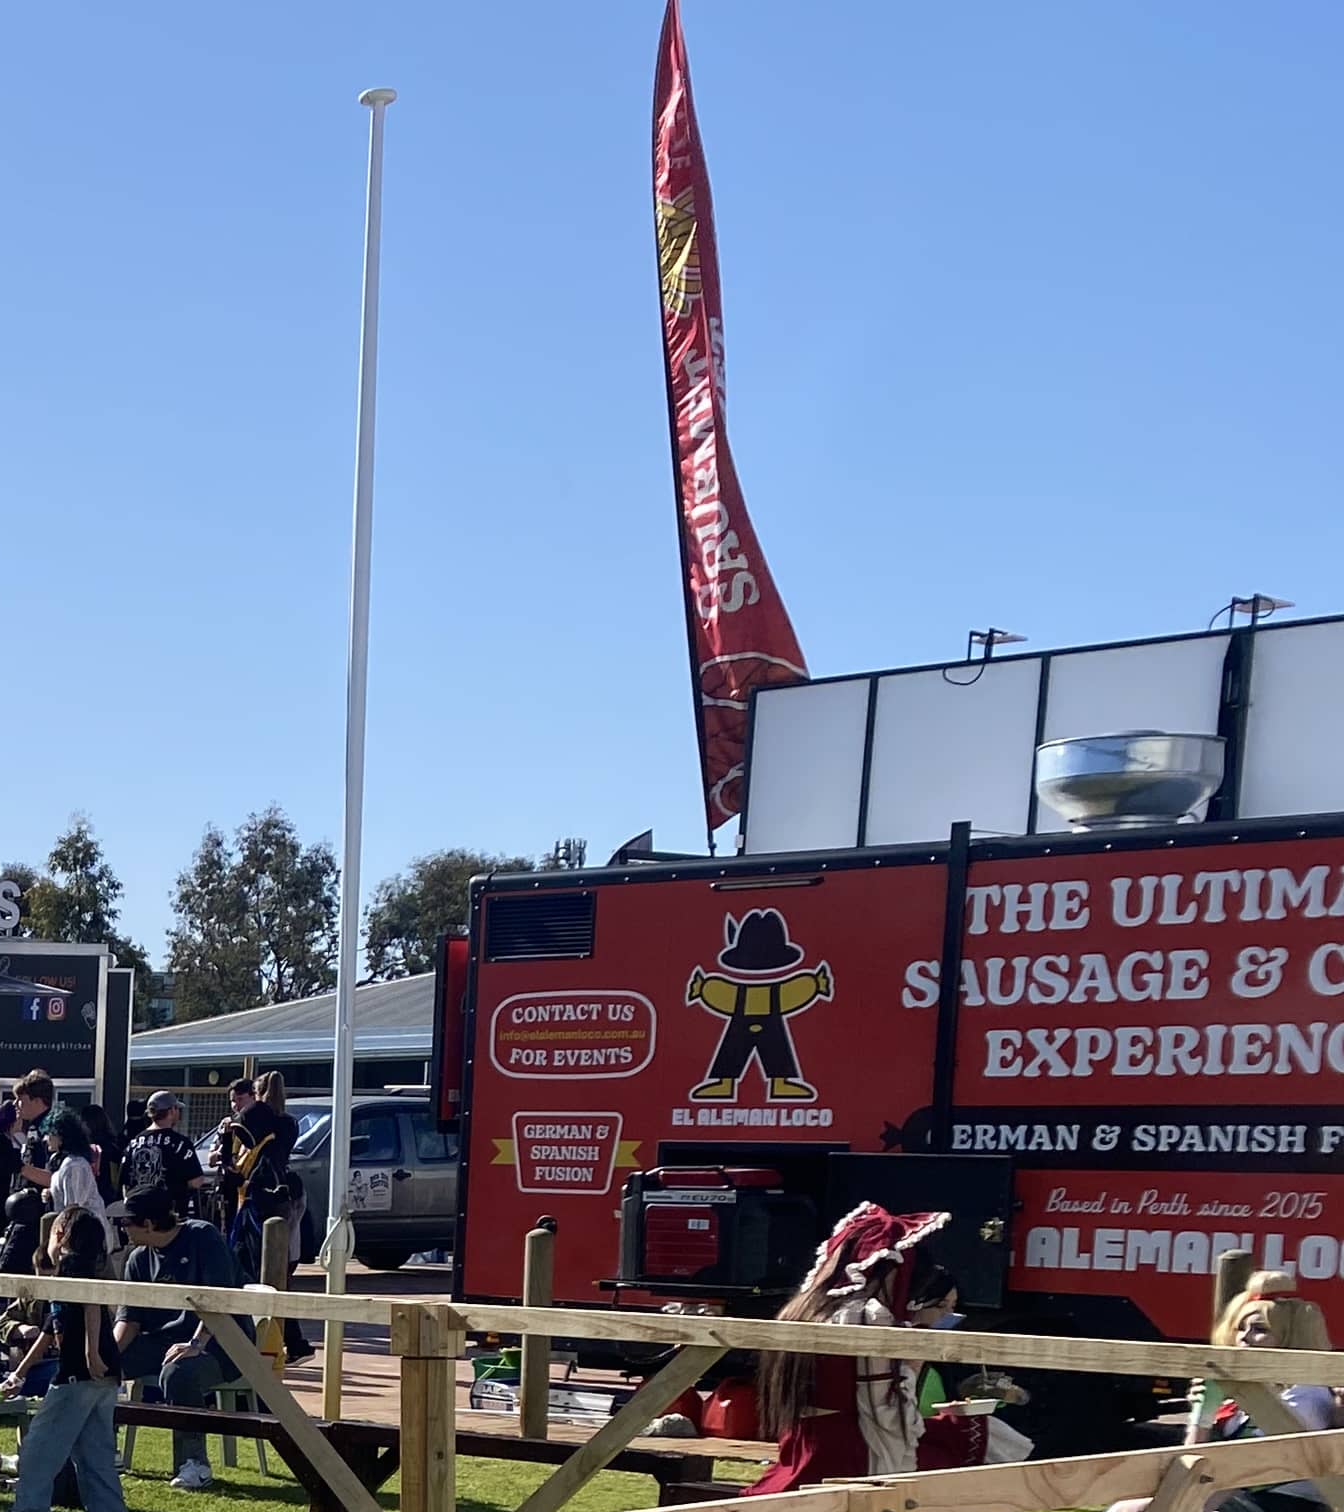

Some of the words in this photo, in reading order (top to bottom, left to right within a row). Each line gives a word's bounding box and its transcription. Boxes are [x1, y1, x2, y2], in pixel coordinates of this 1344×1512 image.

[966, 880, 1090, 934] THE
[902, 949, 1210, 1008] SAUSAGE
[1231, 946, 1289, 999] &
[512, 1004, 602, 1023] CONTACT
[607, 1004, 635, 1021] US
[509, 1048, 548, 1066] FOR
[553, 1046, 633, 1066] EVENTS
[672, 1109, 694, 1125] EL
[697, 1109, 778, 1126] ALEMAN
[780, 1109, 833, 1127] LOCO
[524, 1124, 592, 1139] GERMAN
[596, 1125, 610, 1139] &
[926, 1124, 1081, 1151] ERMAN
[1093, 1124, 1120, 1151] &
[1132, 1124, 1307, 1153] SPANISH
[530, 1145, 600, 1161] SPANISH
[534, 1167, 594, 1181] FUSION
[1045, 1187, 1107, 1214] Based
[1110, 1197, 1133, 1215] in
[1137, 1189, 1191, 1216] Perth
[1197, 1200, 1253, 1218] since
[1259, 1191, 1328, 1219] 2015
[1263, 1233, 1344, 1280] LO
